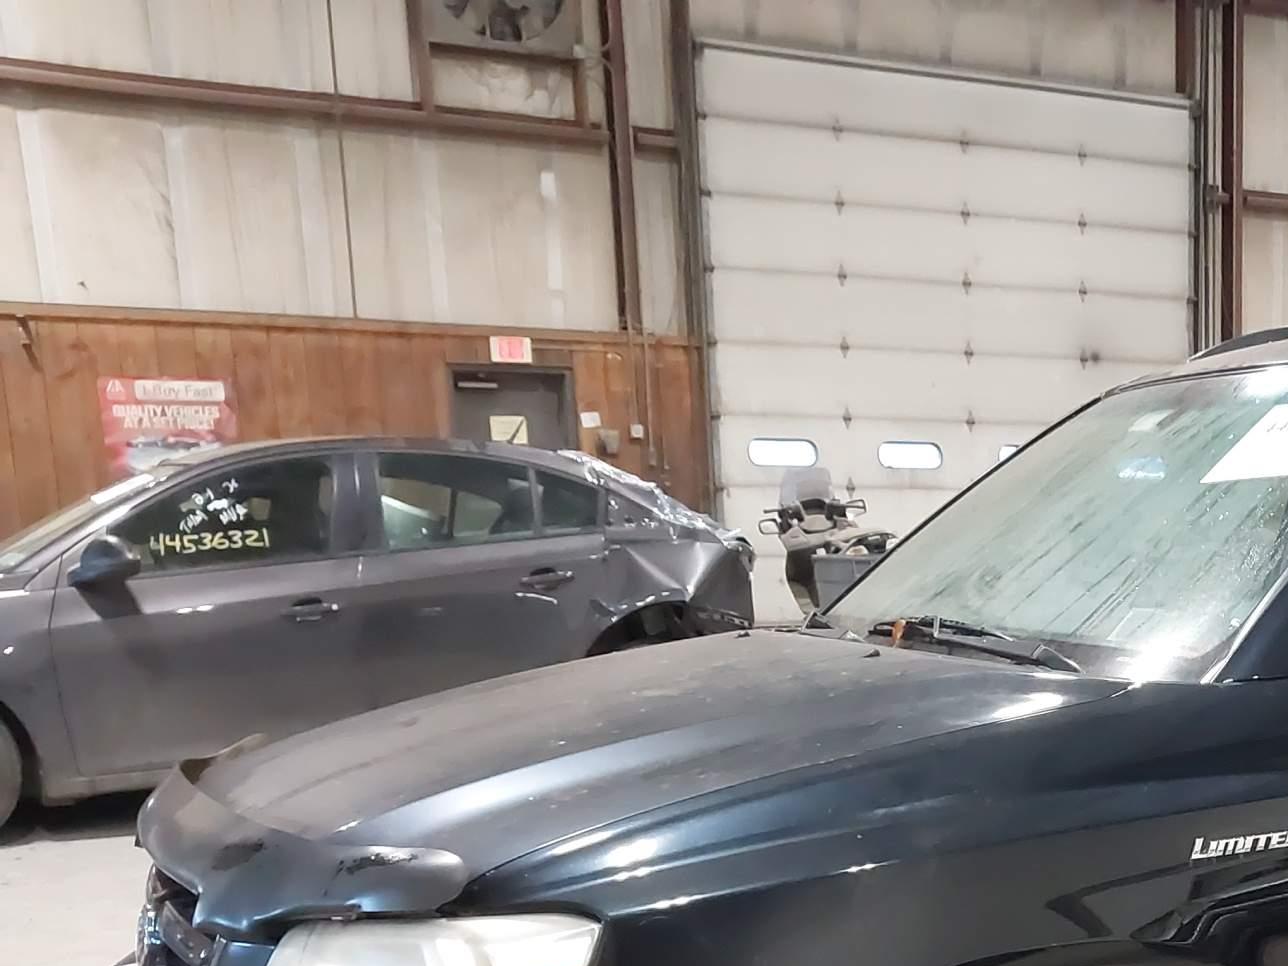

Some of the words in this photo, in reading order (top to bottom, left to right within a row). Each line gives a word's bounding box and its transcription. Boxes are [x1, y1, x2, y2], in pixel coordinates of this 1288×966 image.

[112, 404, 162, 418] QUALITY
[163, 404, 220, 419] VEHICLES
[150, 528, 270, 556] 44536321
